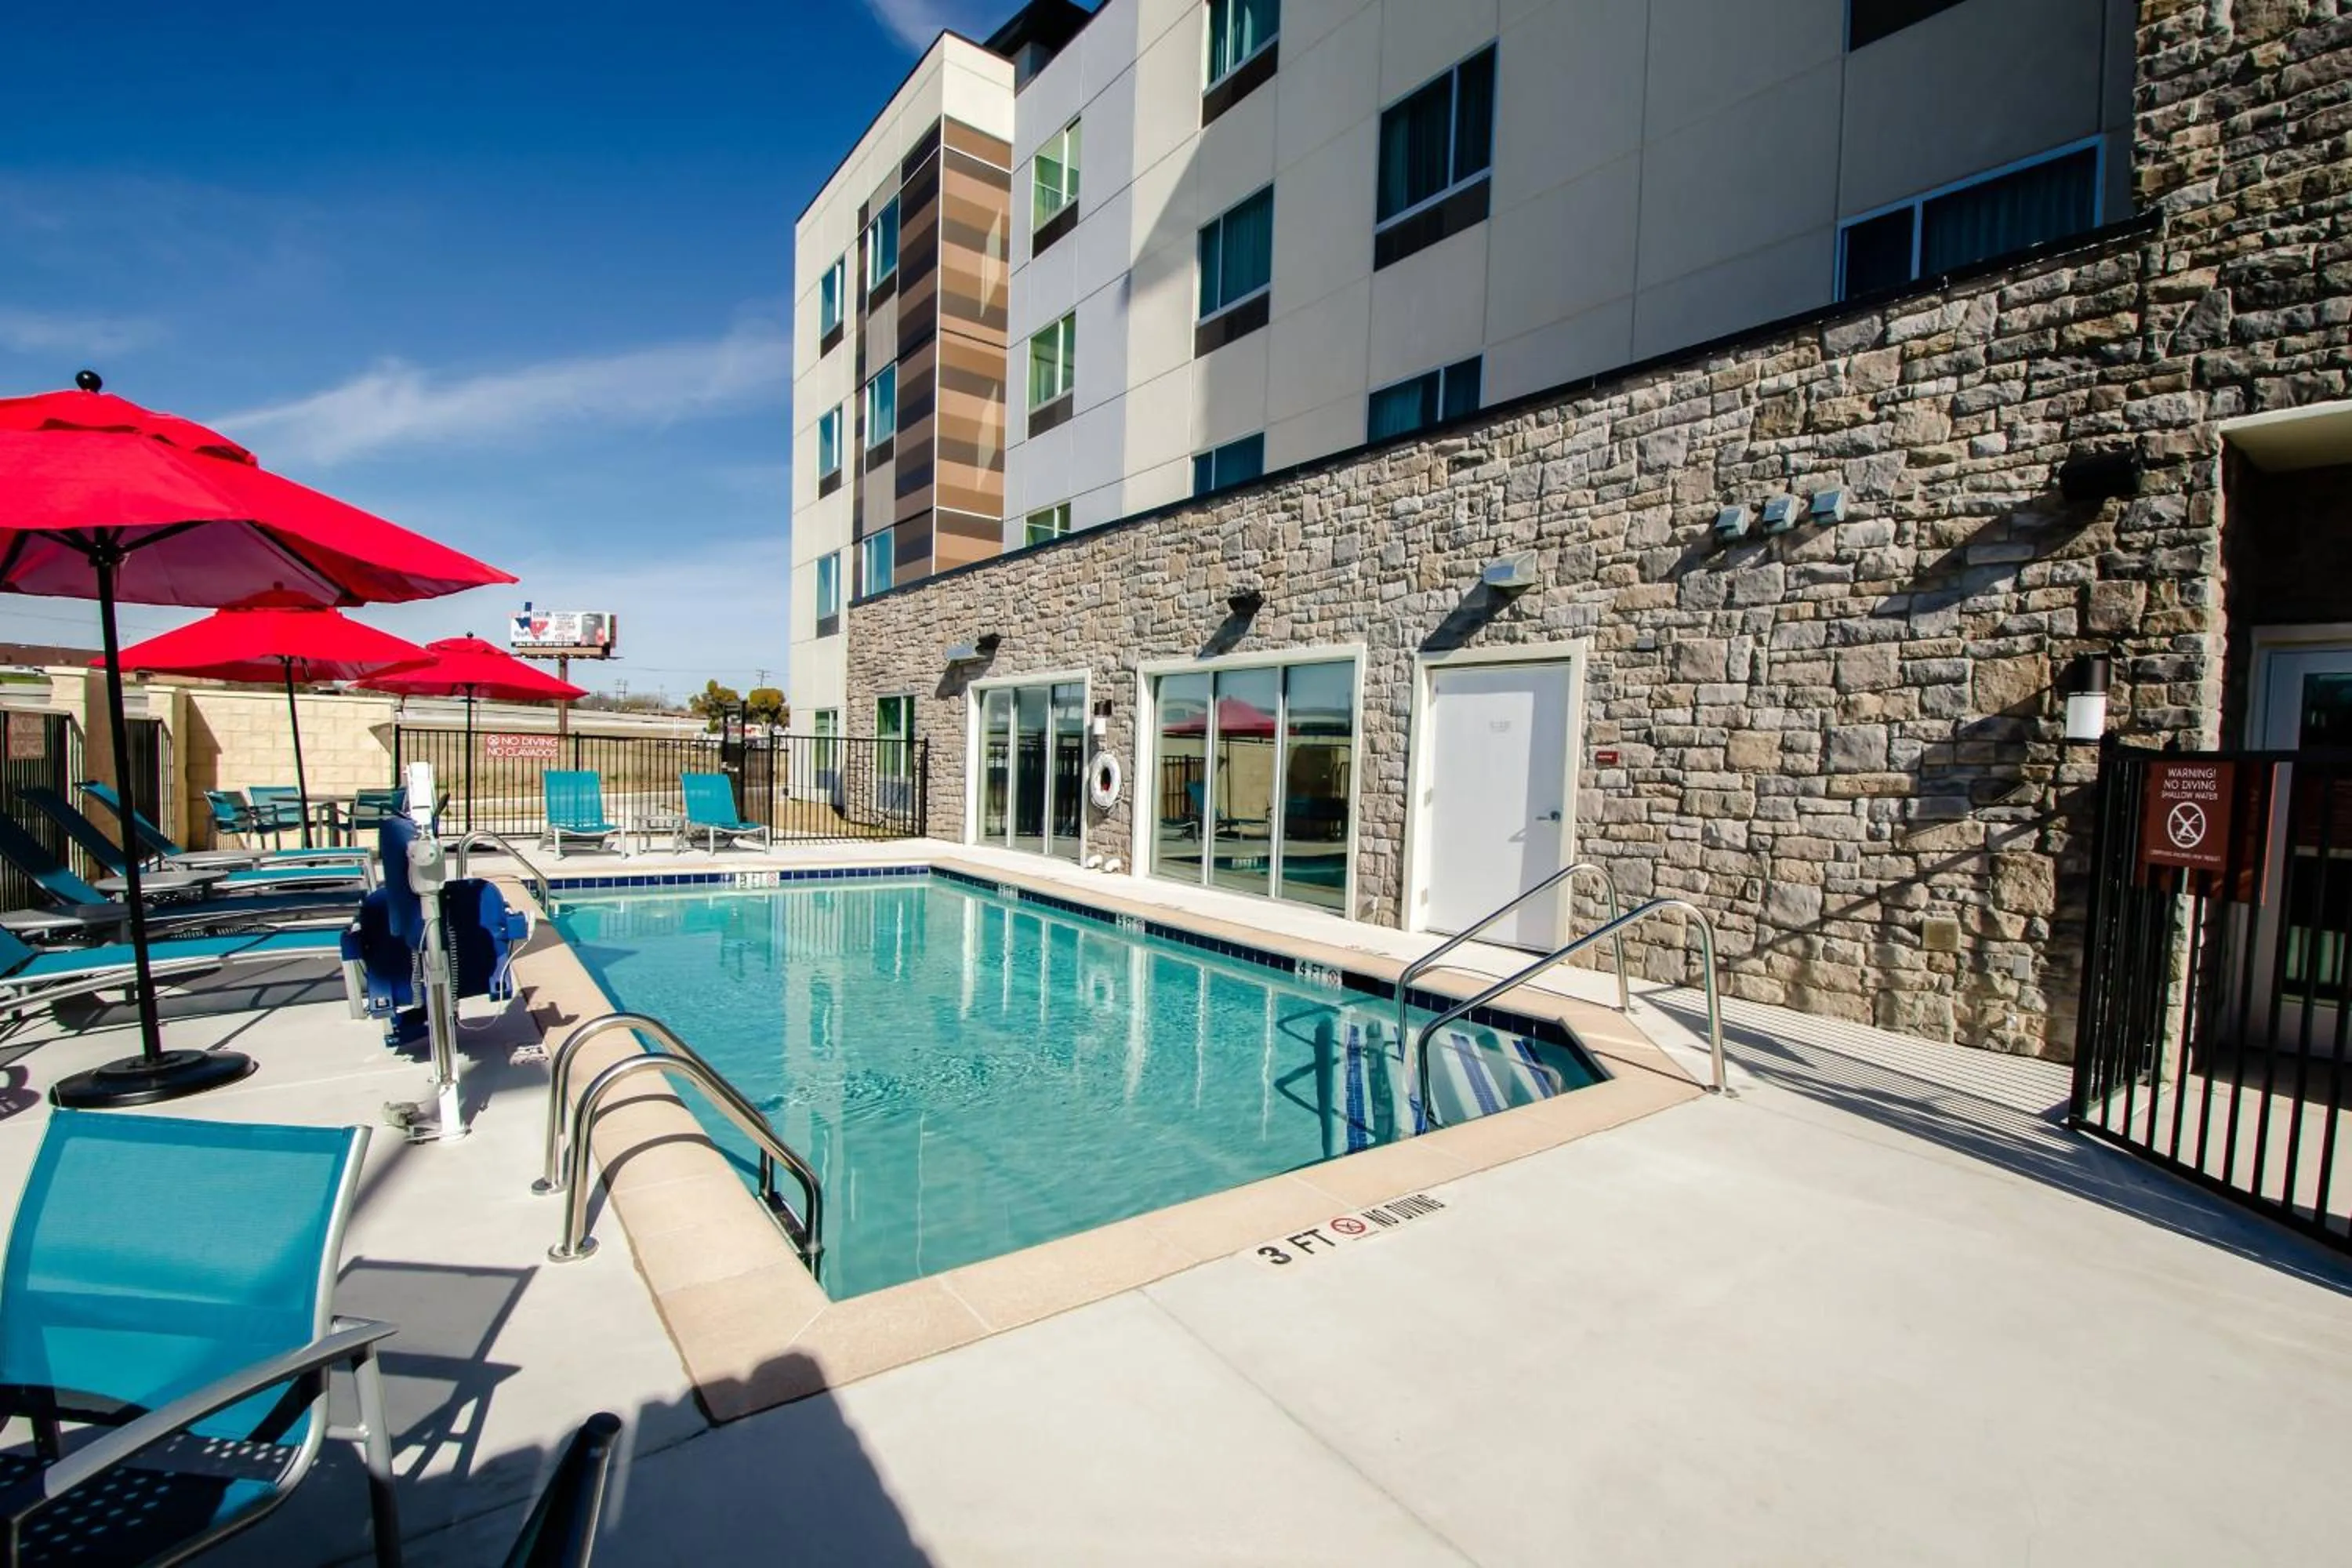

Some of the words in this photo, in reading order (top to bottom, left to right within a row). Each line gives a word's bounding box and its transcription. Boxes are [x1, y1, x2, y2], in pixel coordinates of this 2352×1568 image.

[502, 737, 518, 746] NO
[521, 738, 557, 747] DIVING
[488, 747, 504, 757] NO
[2168, 768, 2216, 779] WARNING!
[2163, 779, 2179, 789] NO
[2181, 780, 2216, 791] DIVING
[2161, 790, 2193, 799] SHALLOW
[2195, 792, 2218, 800] WATER
[1257, 1246, 1292, 1265] 3
[1286, 1229, 1336, 1254] FT
[1360, 1209, 1399, 1228] NO
[1383, 1194, 1446, 1219] DIVING
